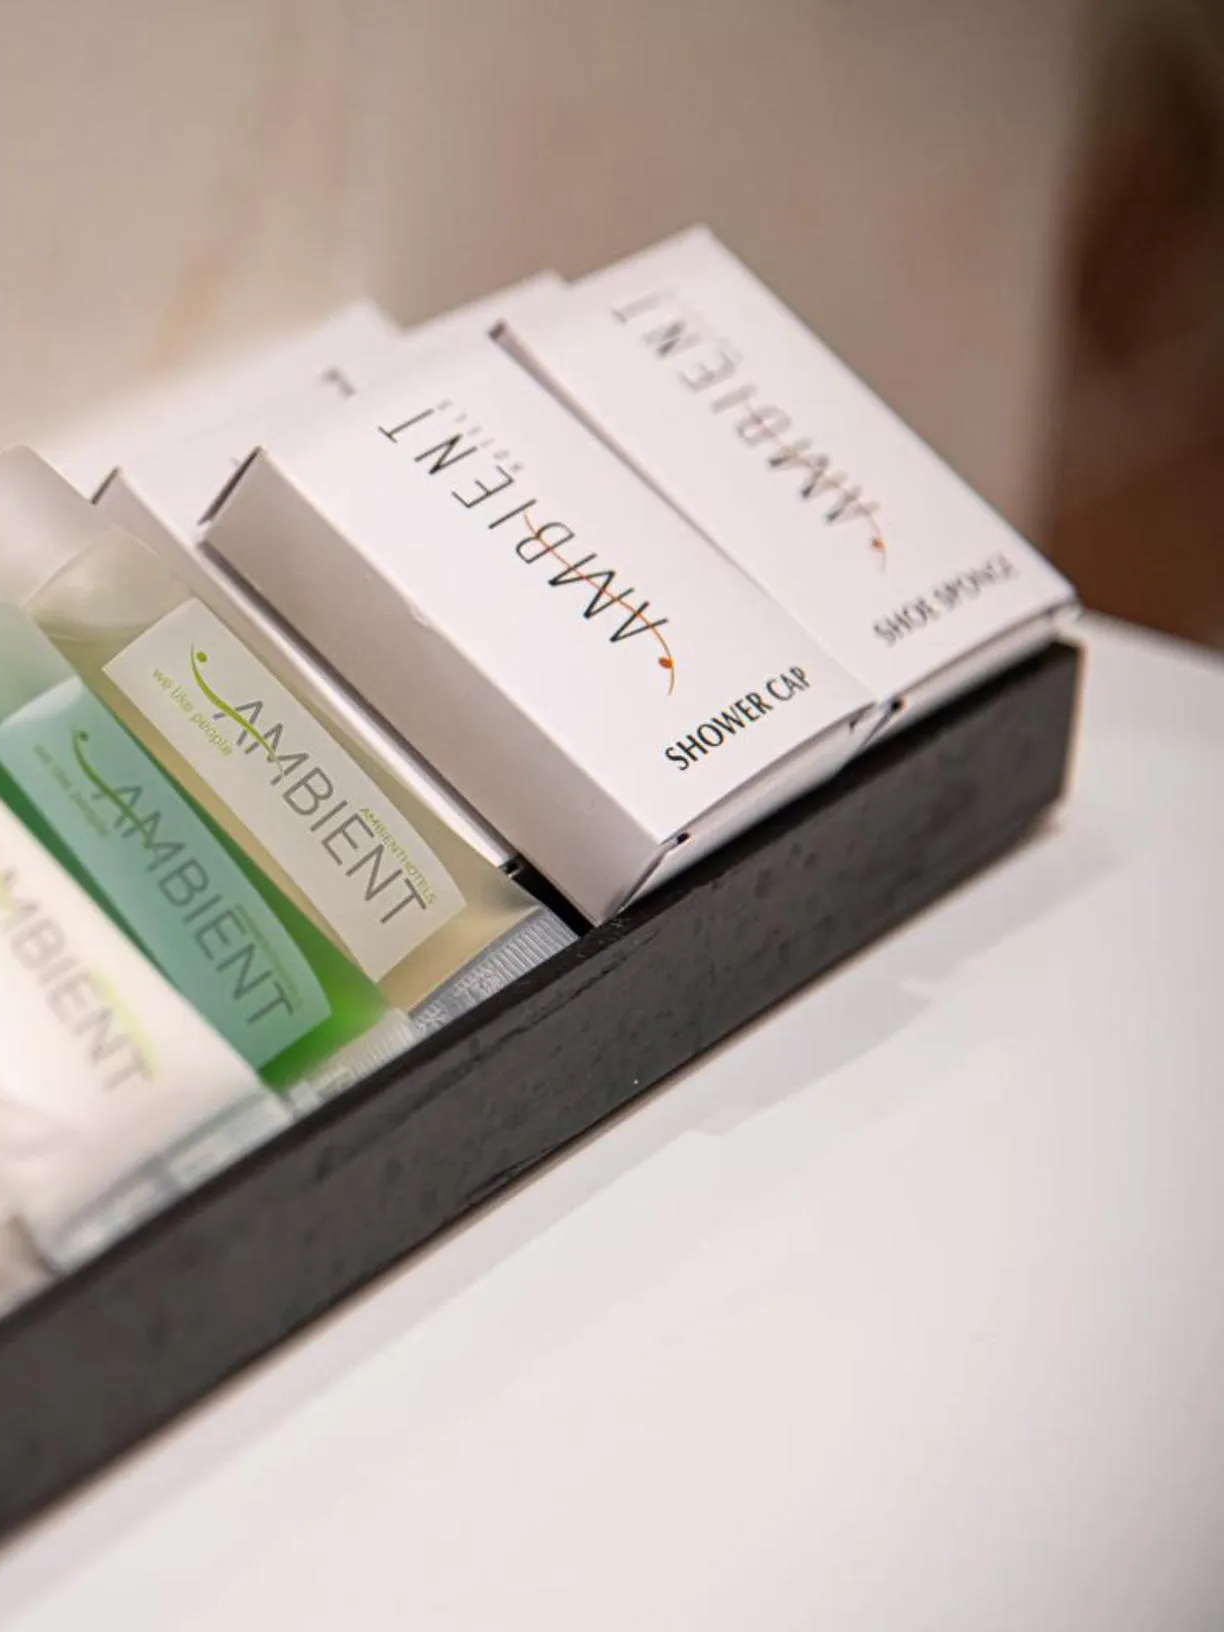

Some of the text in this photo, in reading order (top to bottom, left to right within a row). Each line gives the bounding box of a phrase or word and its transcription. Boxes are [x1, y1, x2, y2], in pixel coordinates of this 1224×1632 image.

[377, 407, 669, 643] AMBIENT
[212, 699, 429, 926] AMBIENT
[664, 664, 813, 772] SHOWER CAP
[91, 784, 294, 1029] AMBIENT
